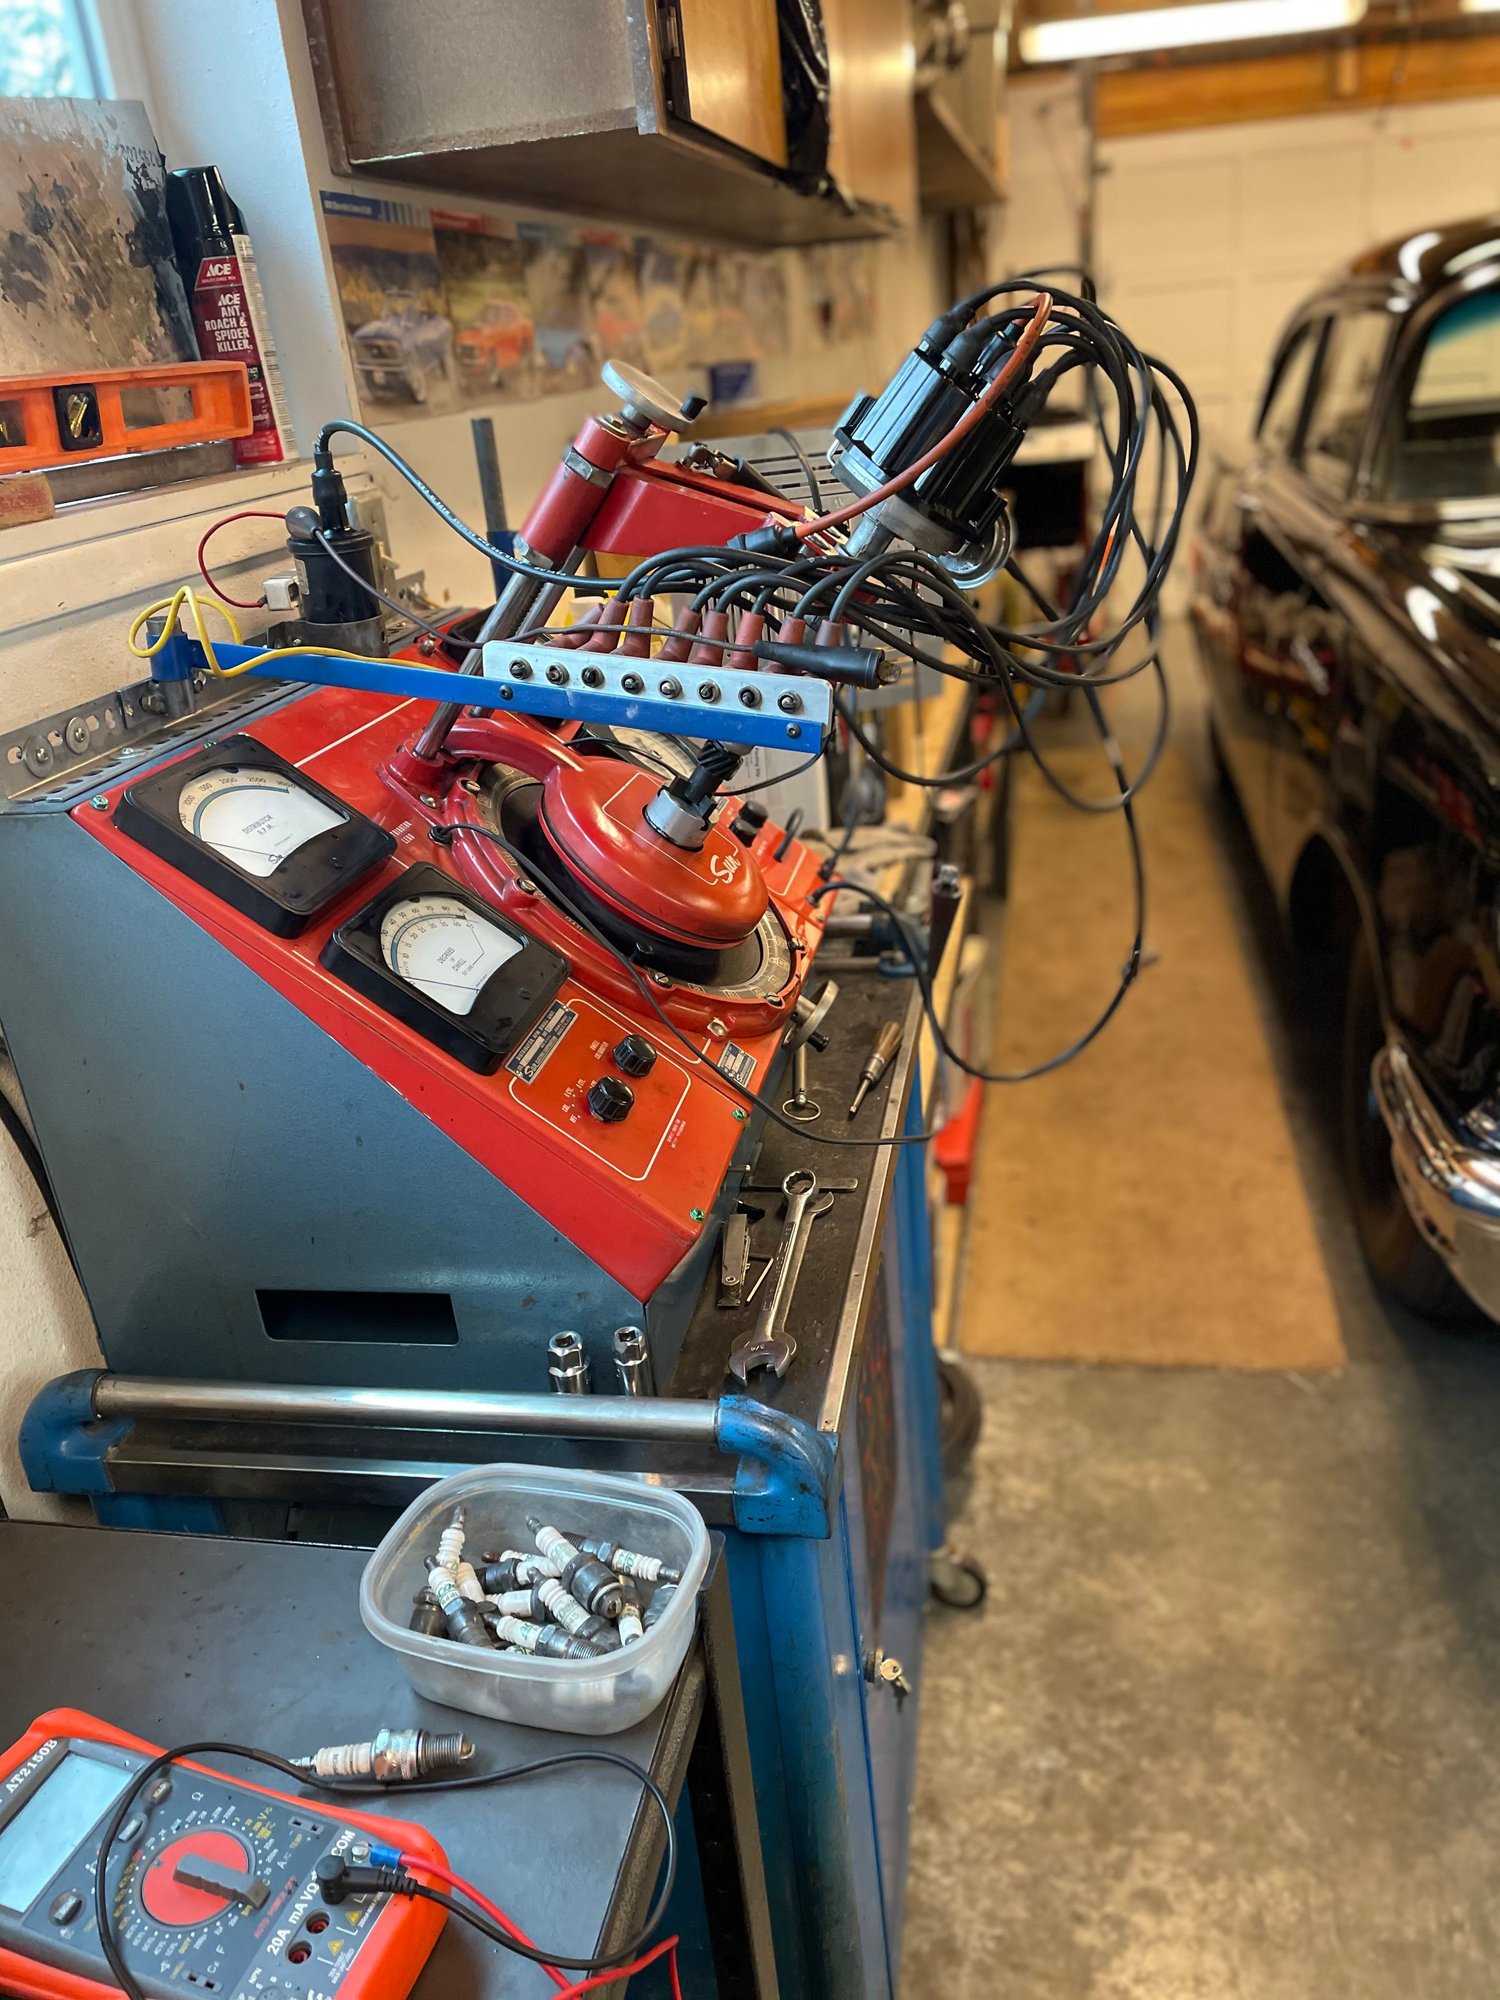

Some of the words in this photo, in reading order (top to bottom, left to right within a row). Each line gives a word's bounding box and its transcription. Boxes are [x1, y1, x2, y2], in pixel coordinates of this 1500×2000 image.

[206, 263, 231, 277] ACE
[218, 293, 240, 306] ACE
[221, 305, 245, 318] ANT,
[205, 317, 237, 331] ROACH
[239, 315, 247, 328] &
[216, 327, 250, 341] SPIDER
[436, 501, 450, 516] MADE
[709, 854, 741, 884] Sun
[437, 947, 455, 964] DEGREES
[452, 958, 467, 972] DWELL
[5, 1739, 58, 1794] AT2150B
[331, 1829, 356, 1857] COM
[266, 1928, 291, 1957] 20A
[288, 1903, 308, 1925] mA
